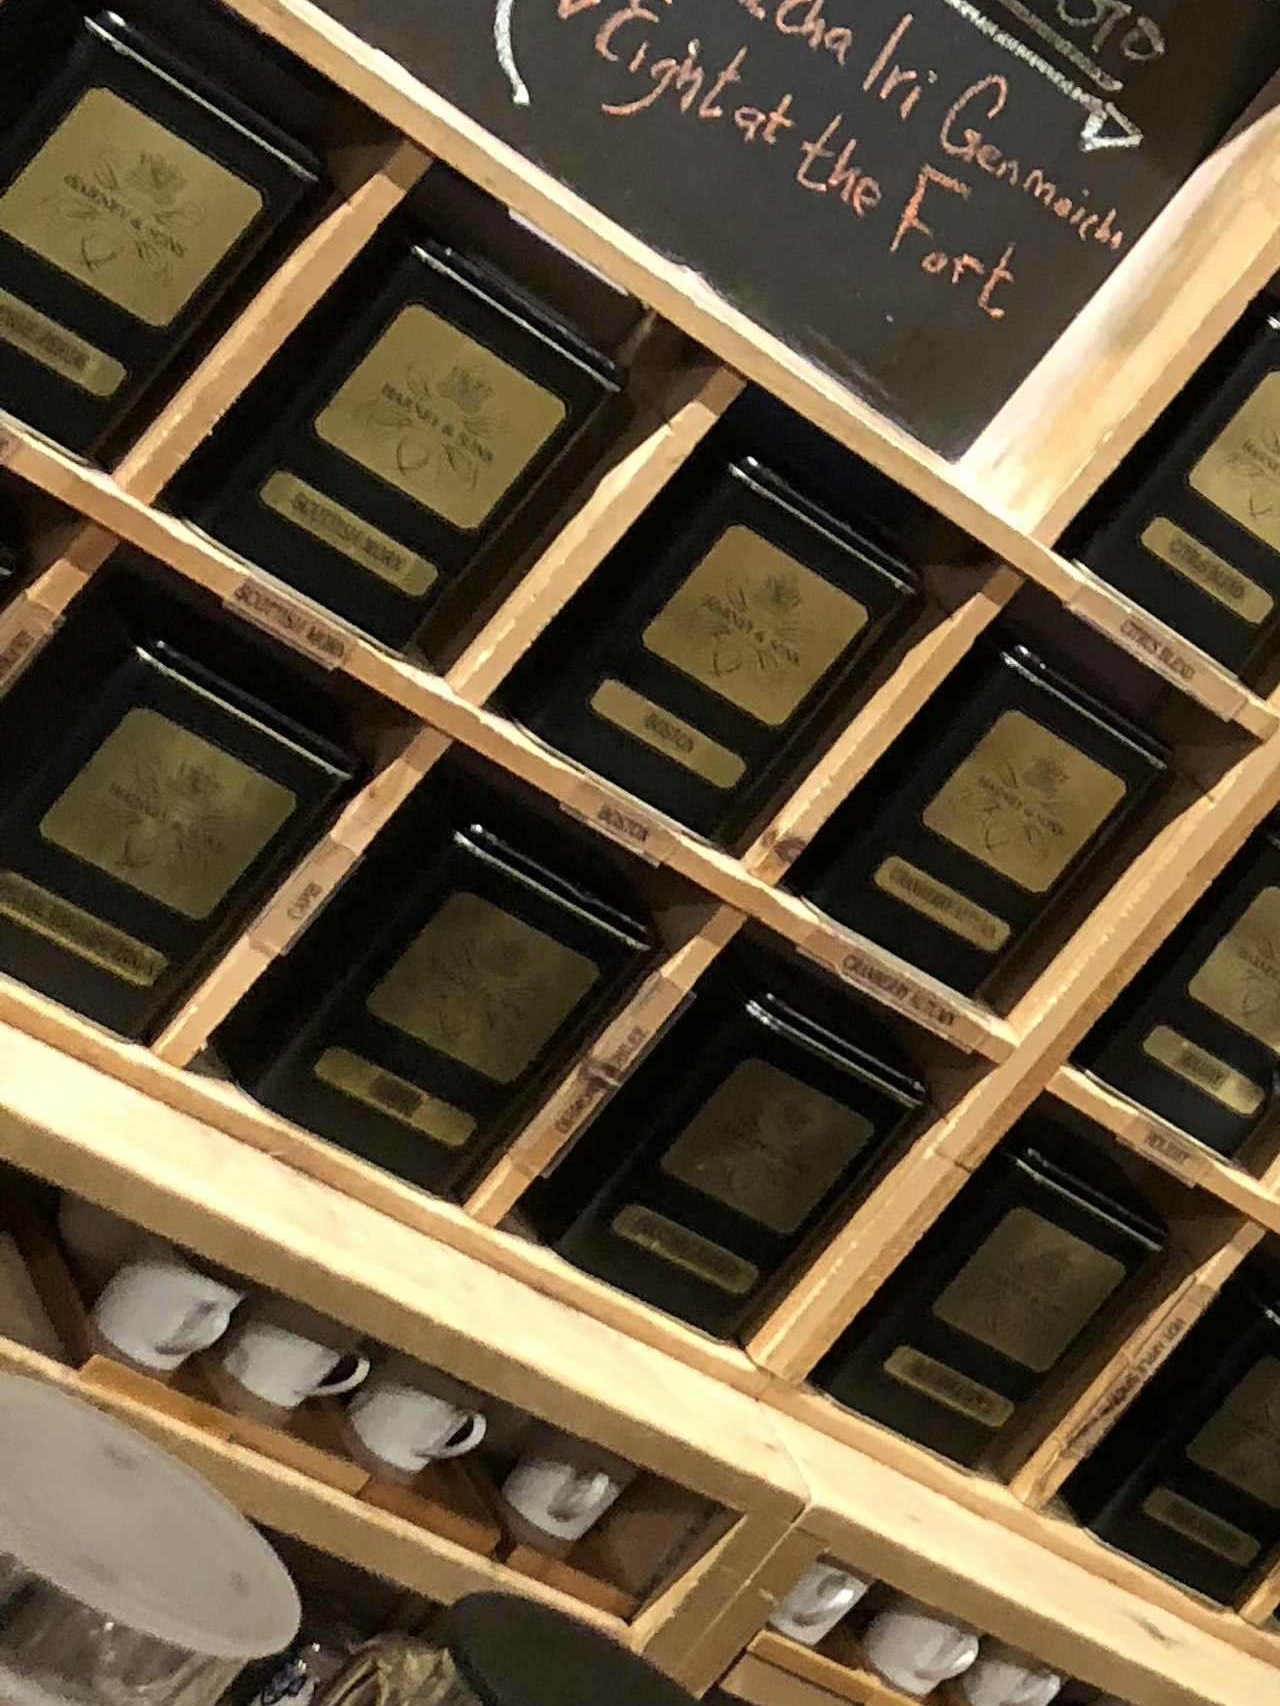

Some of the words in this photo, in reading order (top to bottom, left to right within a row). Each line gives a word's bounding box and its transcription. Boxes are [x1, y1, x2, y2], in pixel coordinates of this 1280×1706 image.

[729, 94, 789, 143] at
[793, 114, 881, 216] the
[378, 381, 441, 428] HARNEY
